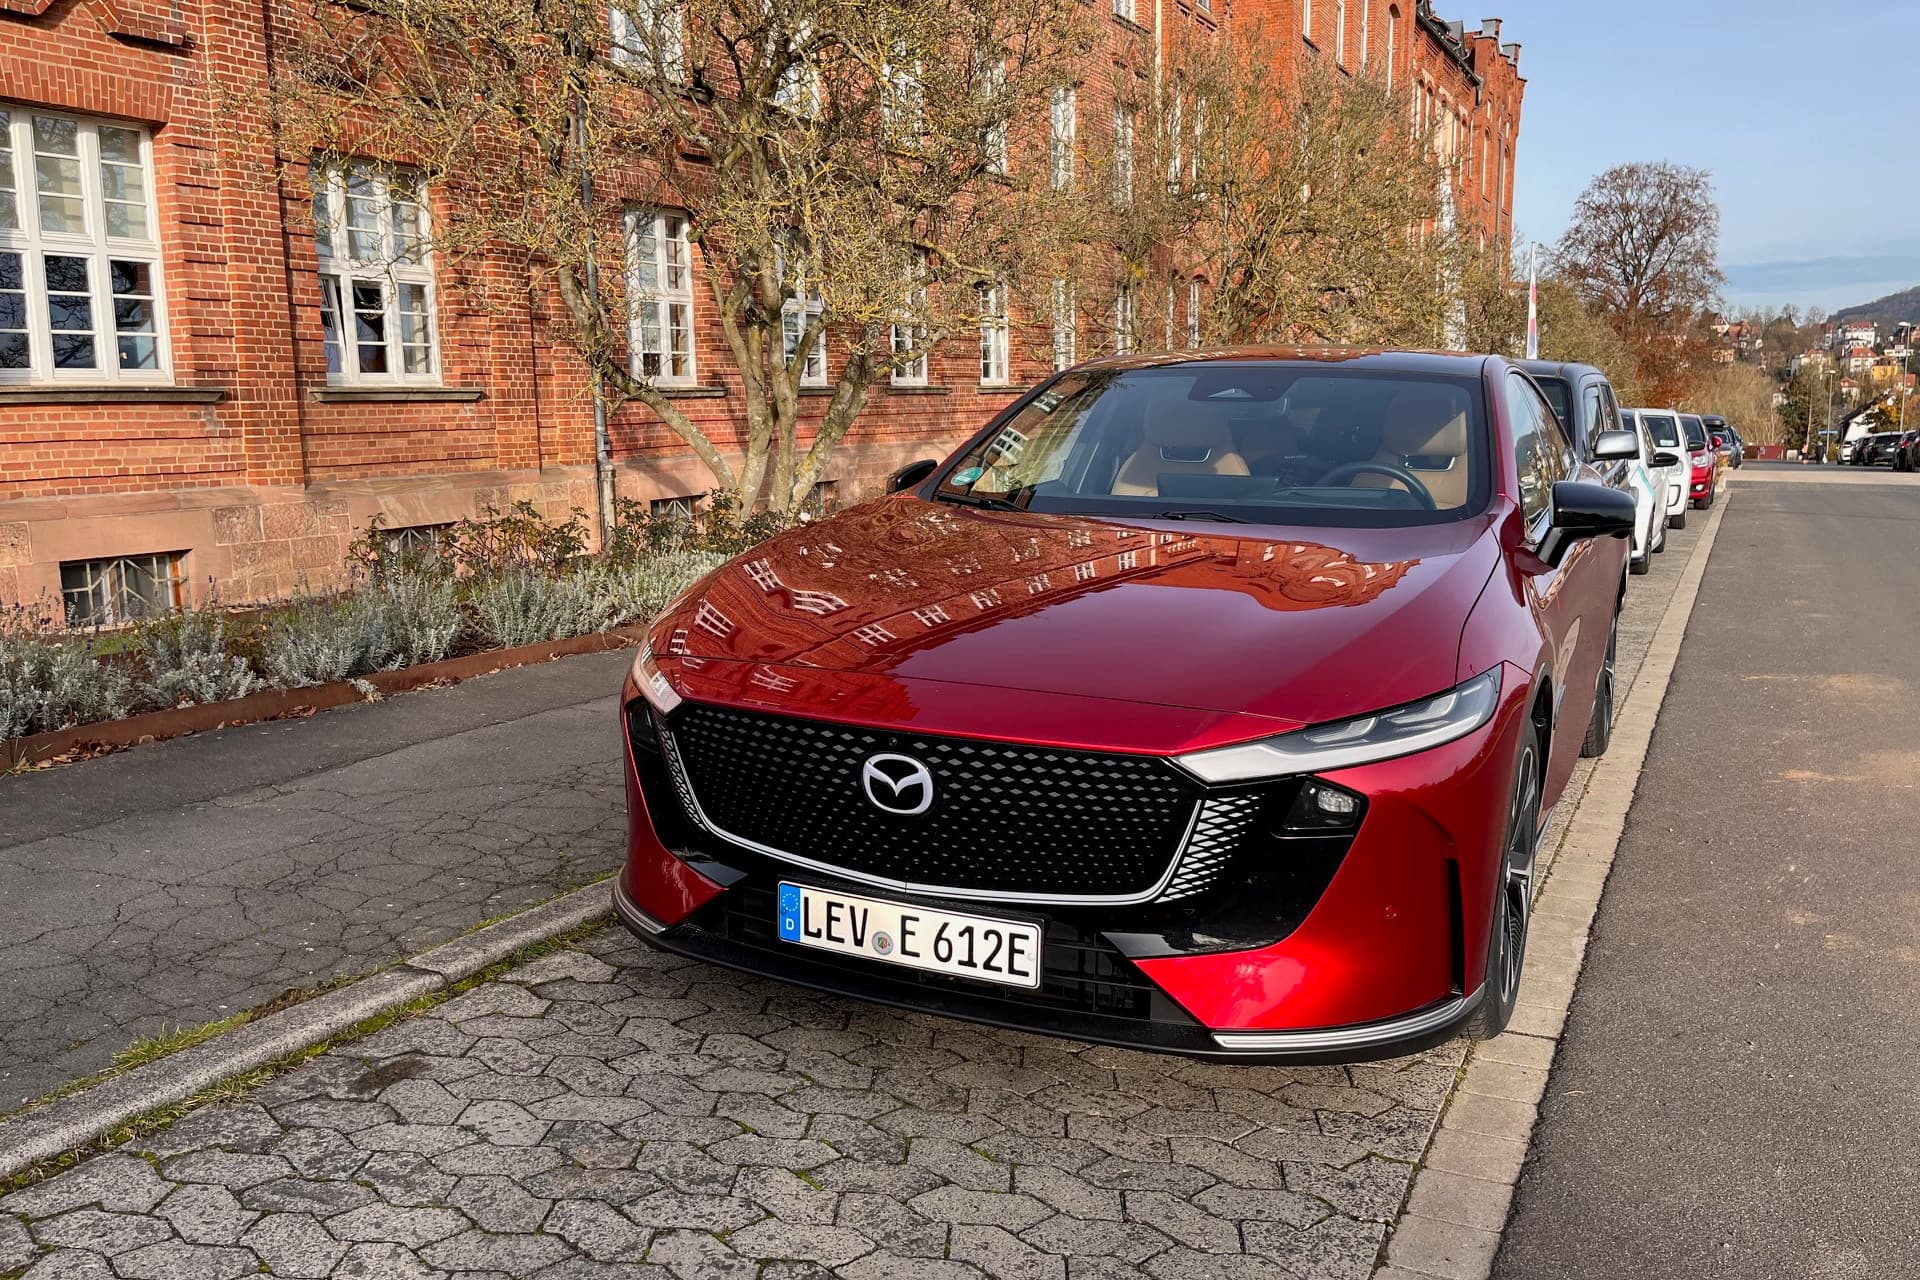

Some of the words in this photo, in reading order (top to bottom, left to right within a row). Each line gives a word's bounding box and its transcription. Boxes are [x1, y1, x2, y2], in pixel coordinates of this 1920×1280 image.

[785, 917, 795, 931] D
[803, 896, 869, 948] LEV
[900, 914, 921, 958] E
[933, 922, 1030, 977] 612E
